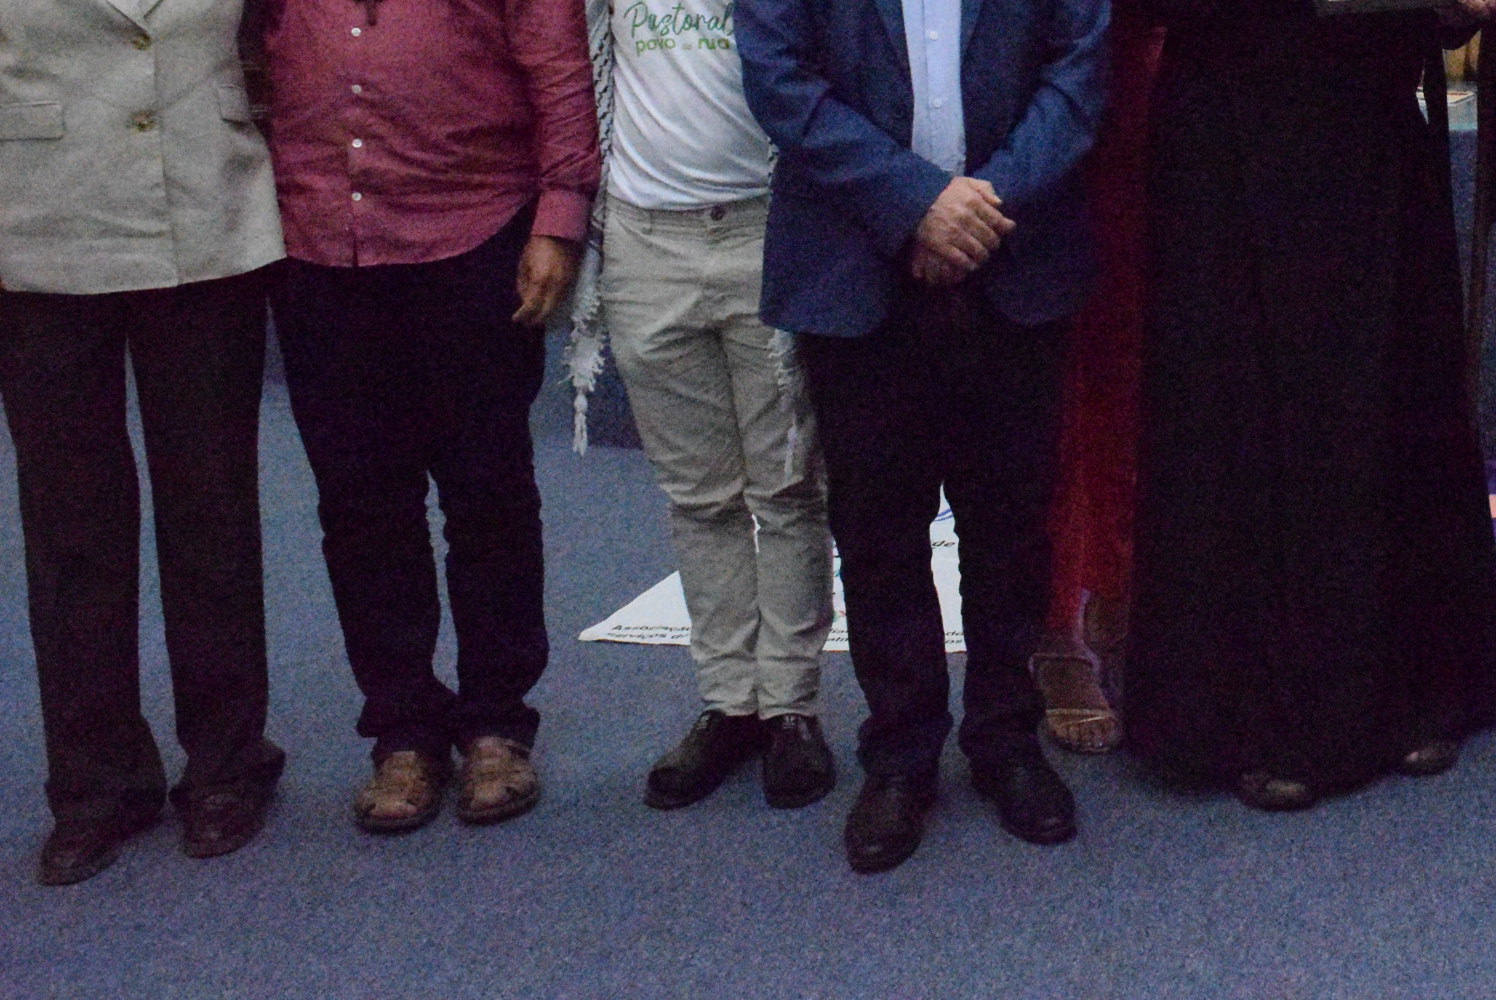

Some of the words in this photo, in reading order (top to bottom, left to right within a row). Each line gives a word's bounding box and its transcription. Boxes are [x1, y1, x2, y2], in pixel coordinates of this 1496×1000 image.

[623, 1, 735, 39] Pastoral
[635, 37, 676, 57] povo
[697, 38, 731, 51] rua
